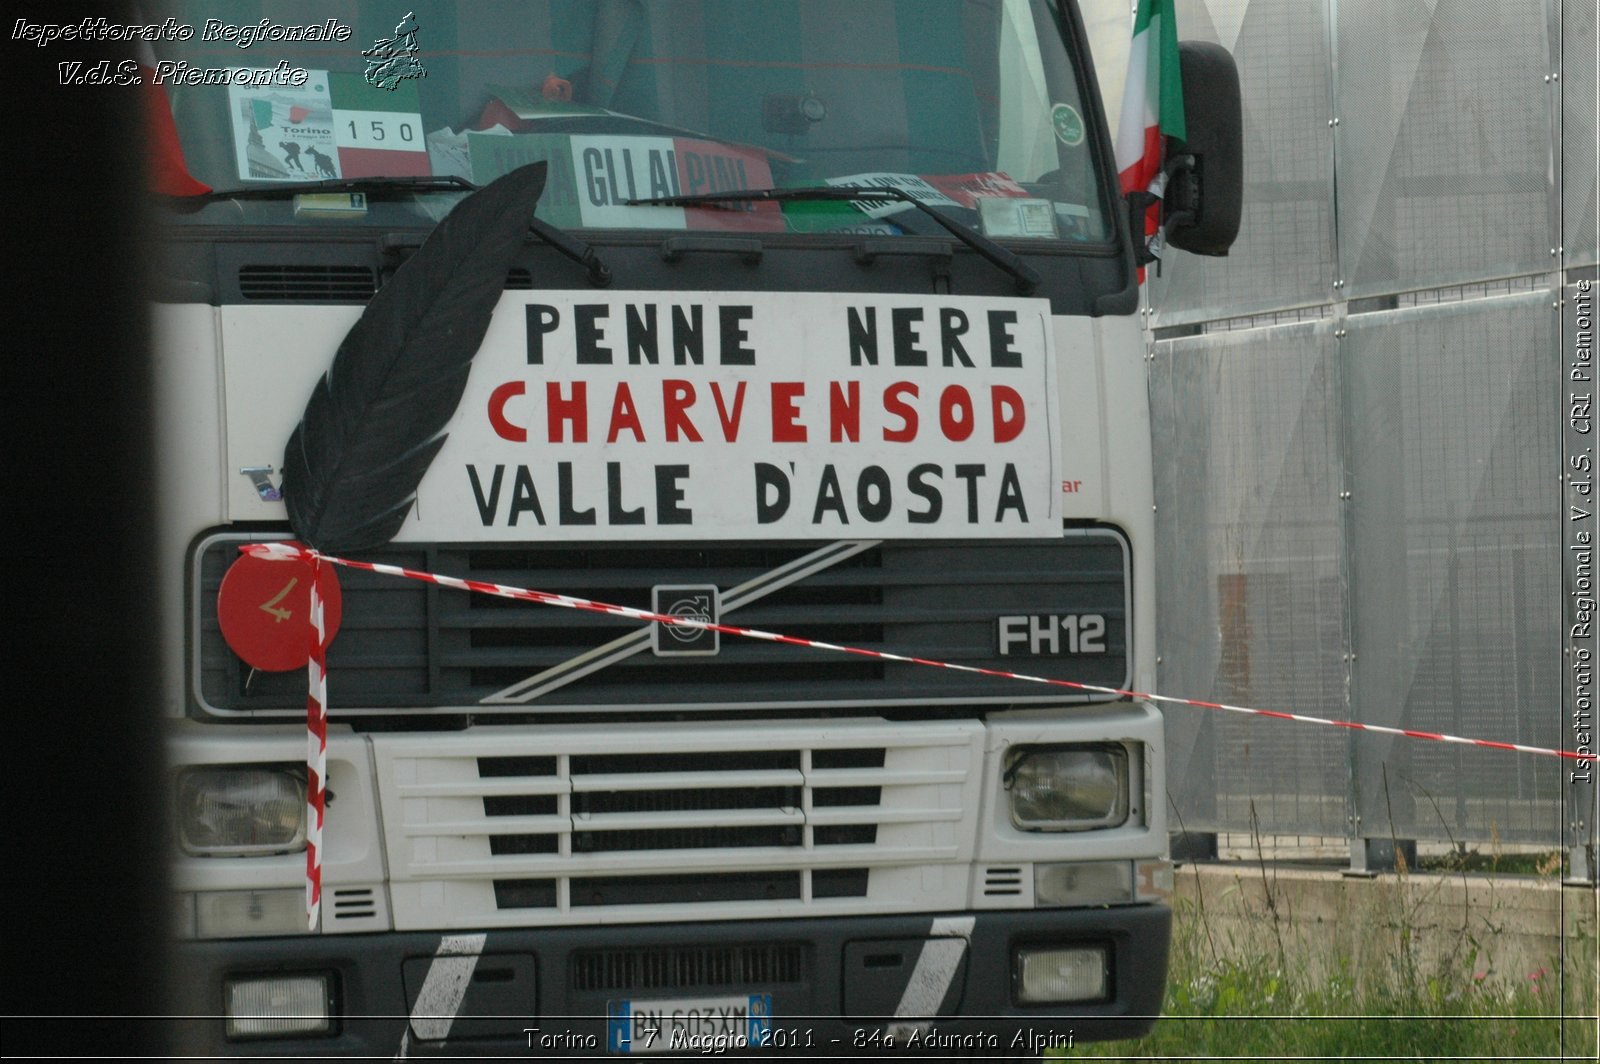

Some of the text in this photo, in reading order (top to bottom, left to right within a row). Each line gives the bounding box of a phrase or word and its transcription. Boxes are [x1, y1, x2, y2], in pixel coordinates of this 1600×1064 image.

[280, 126, 331, 135] Torino
[582, 147, 638, 207] GLI
[525, 303, 1023, 368] PENNE NERE
[487, 379, 1026, 443] CHARVENSOD
[465, 461, 1029, 526] VALLE D'AOSTA
[259, 577, 298, 624] 4
[998, 614, 1106, 655] FH12
